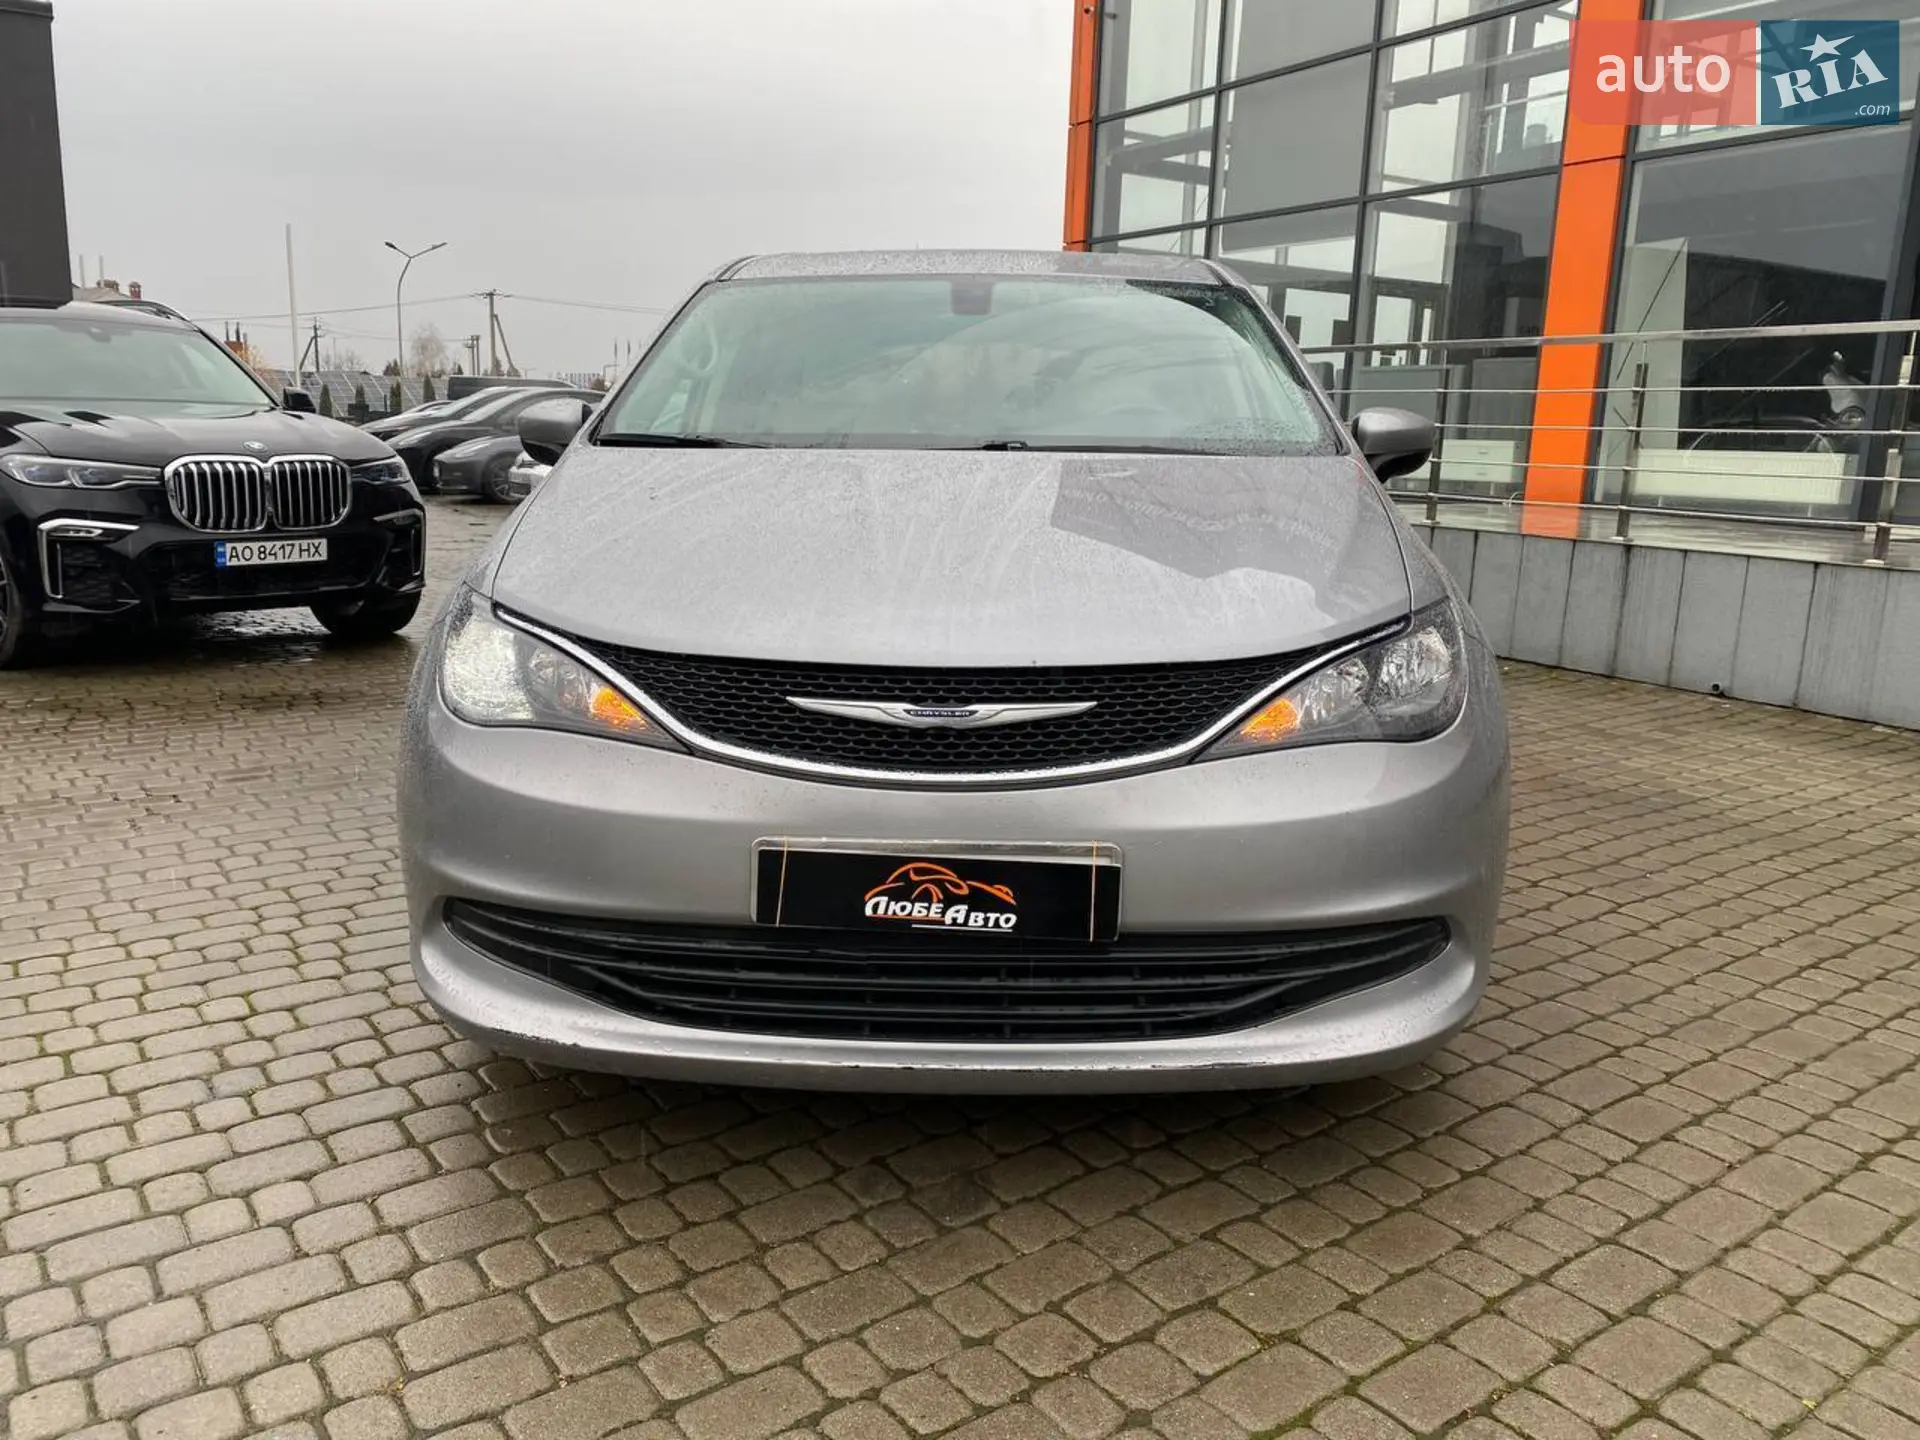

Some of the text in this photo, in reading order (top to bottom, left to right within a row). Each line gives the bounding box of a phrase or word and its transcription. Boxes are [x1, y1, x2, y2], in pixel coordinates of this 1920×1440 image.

[229, 541, 322, 562] AO 8417 HX
